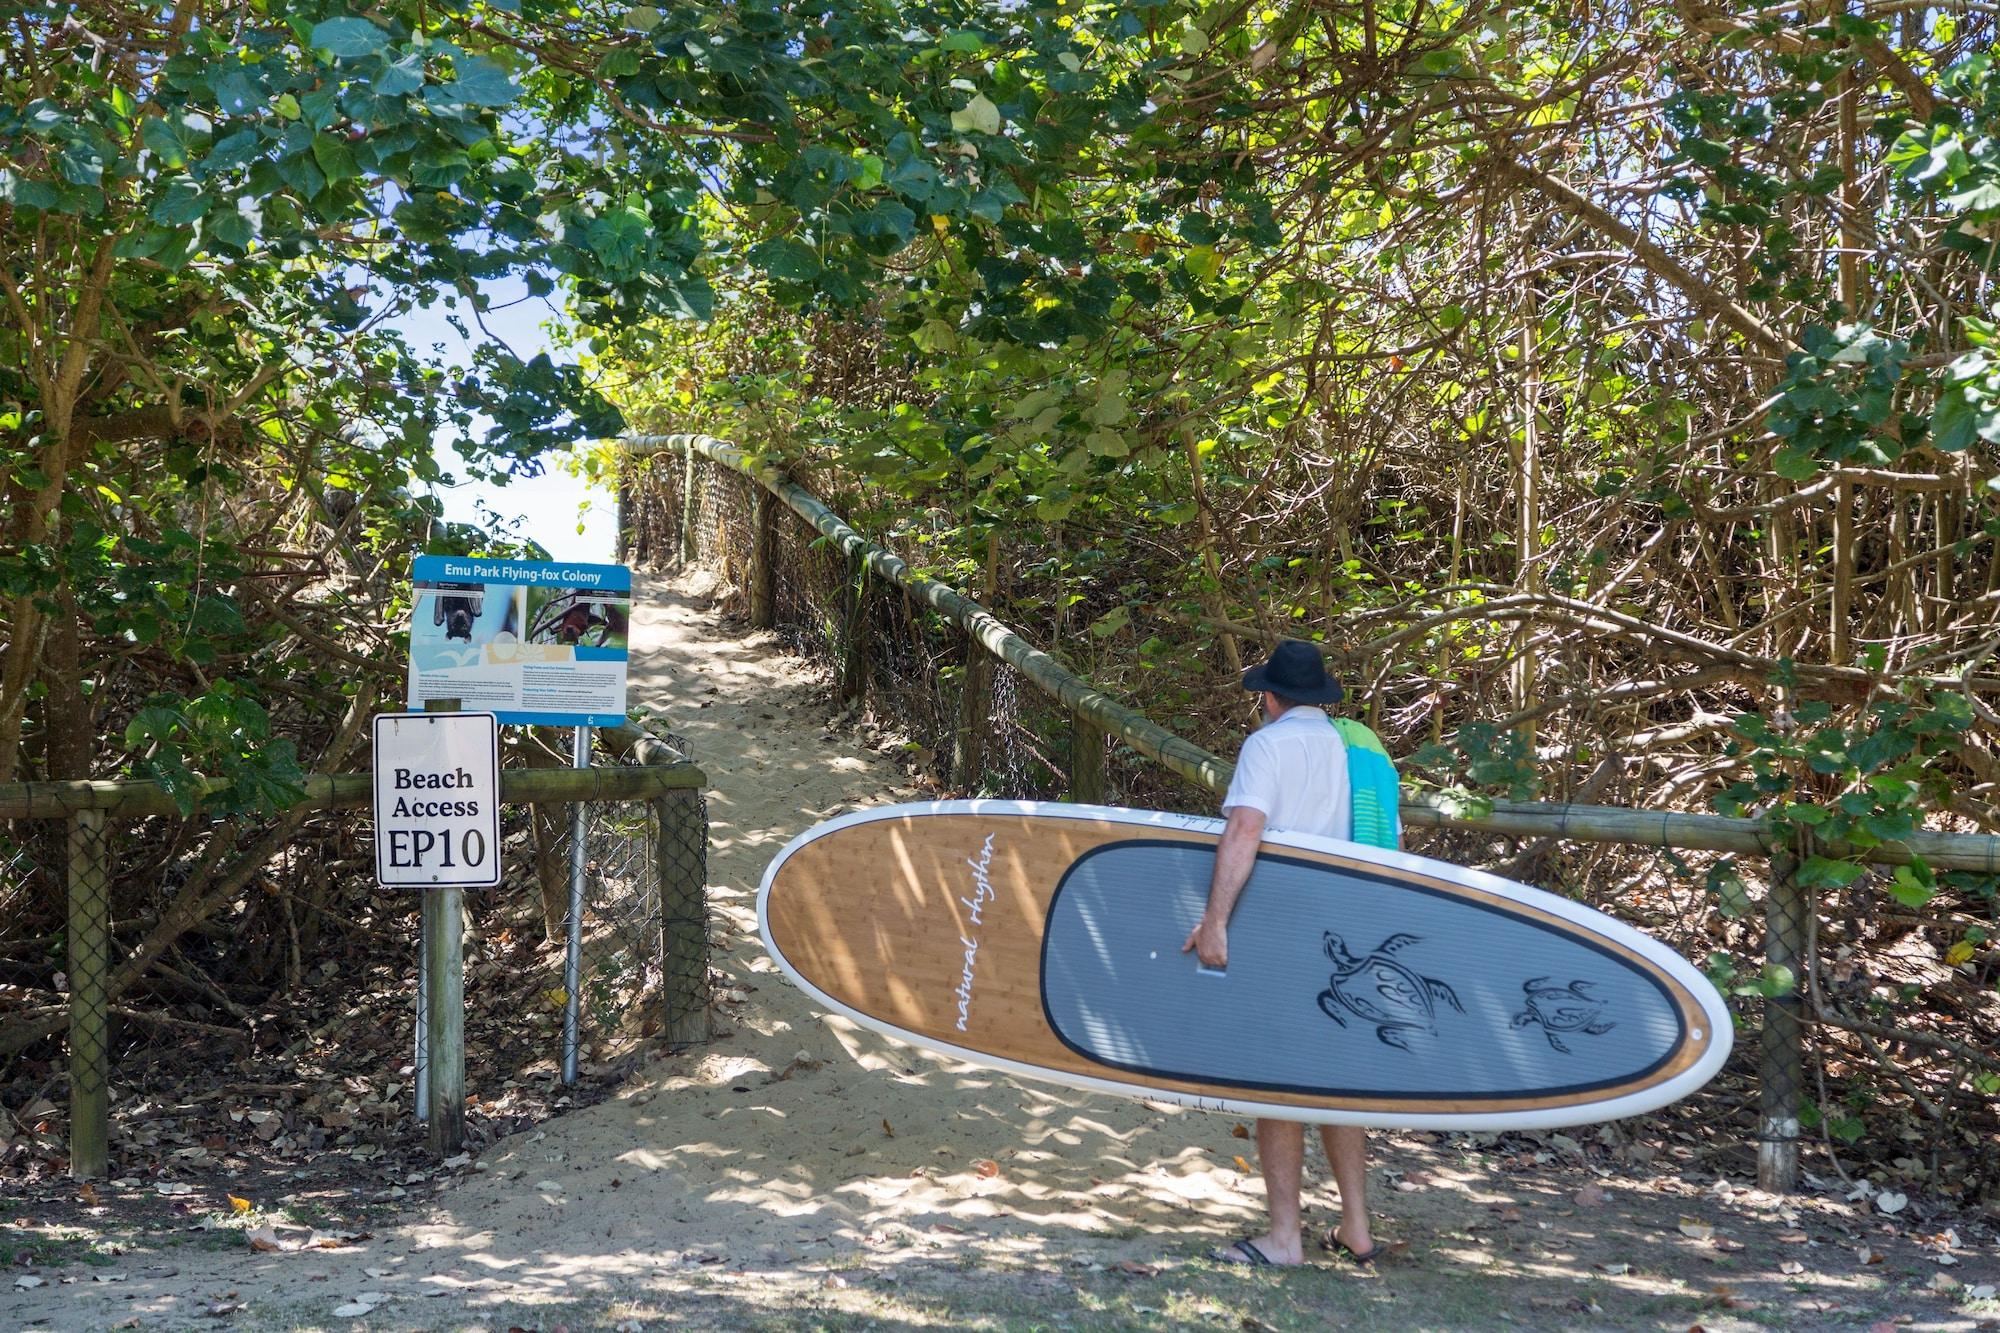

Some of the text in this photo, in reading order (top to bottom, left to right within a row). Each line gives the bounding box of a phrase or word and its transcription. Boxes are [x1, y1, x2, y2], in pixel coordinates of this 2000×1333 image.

[445, 564, 601, 584] Emu Park Flying-fox Colony
[394, 767, 474, 789] Beach
[391, 797, 479, 818] Access
[388, 829, 485, 868] EP10
[956, 832, 995, 1032] natural rhythm
